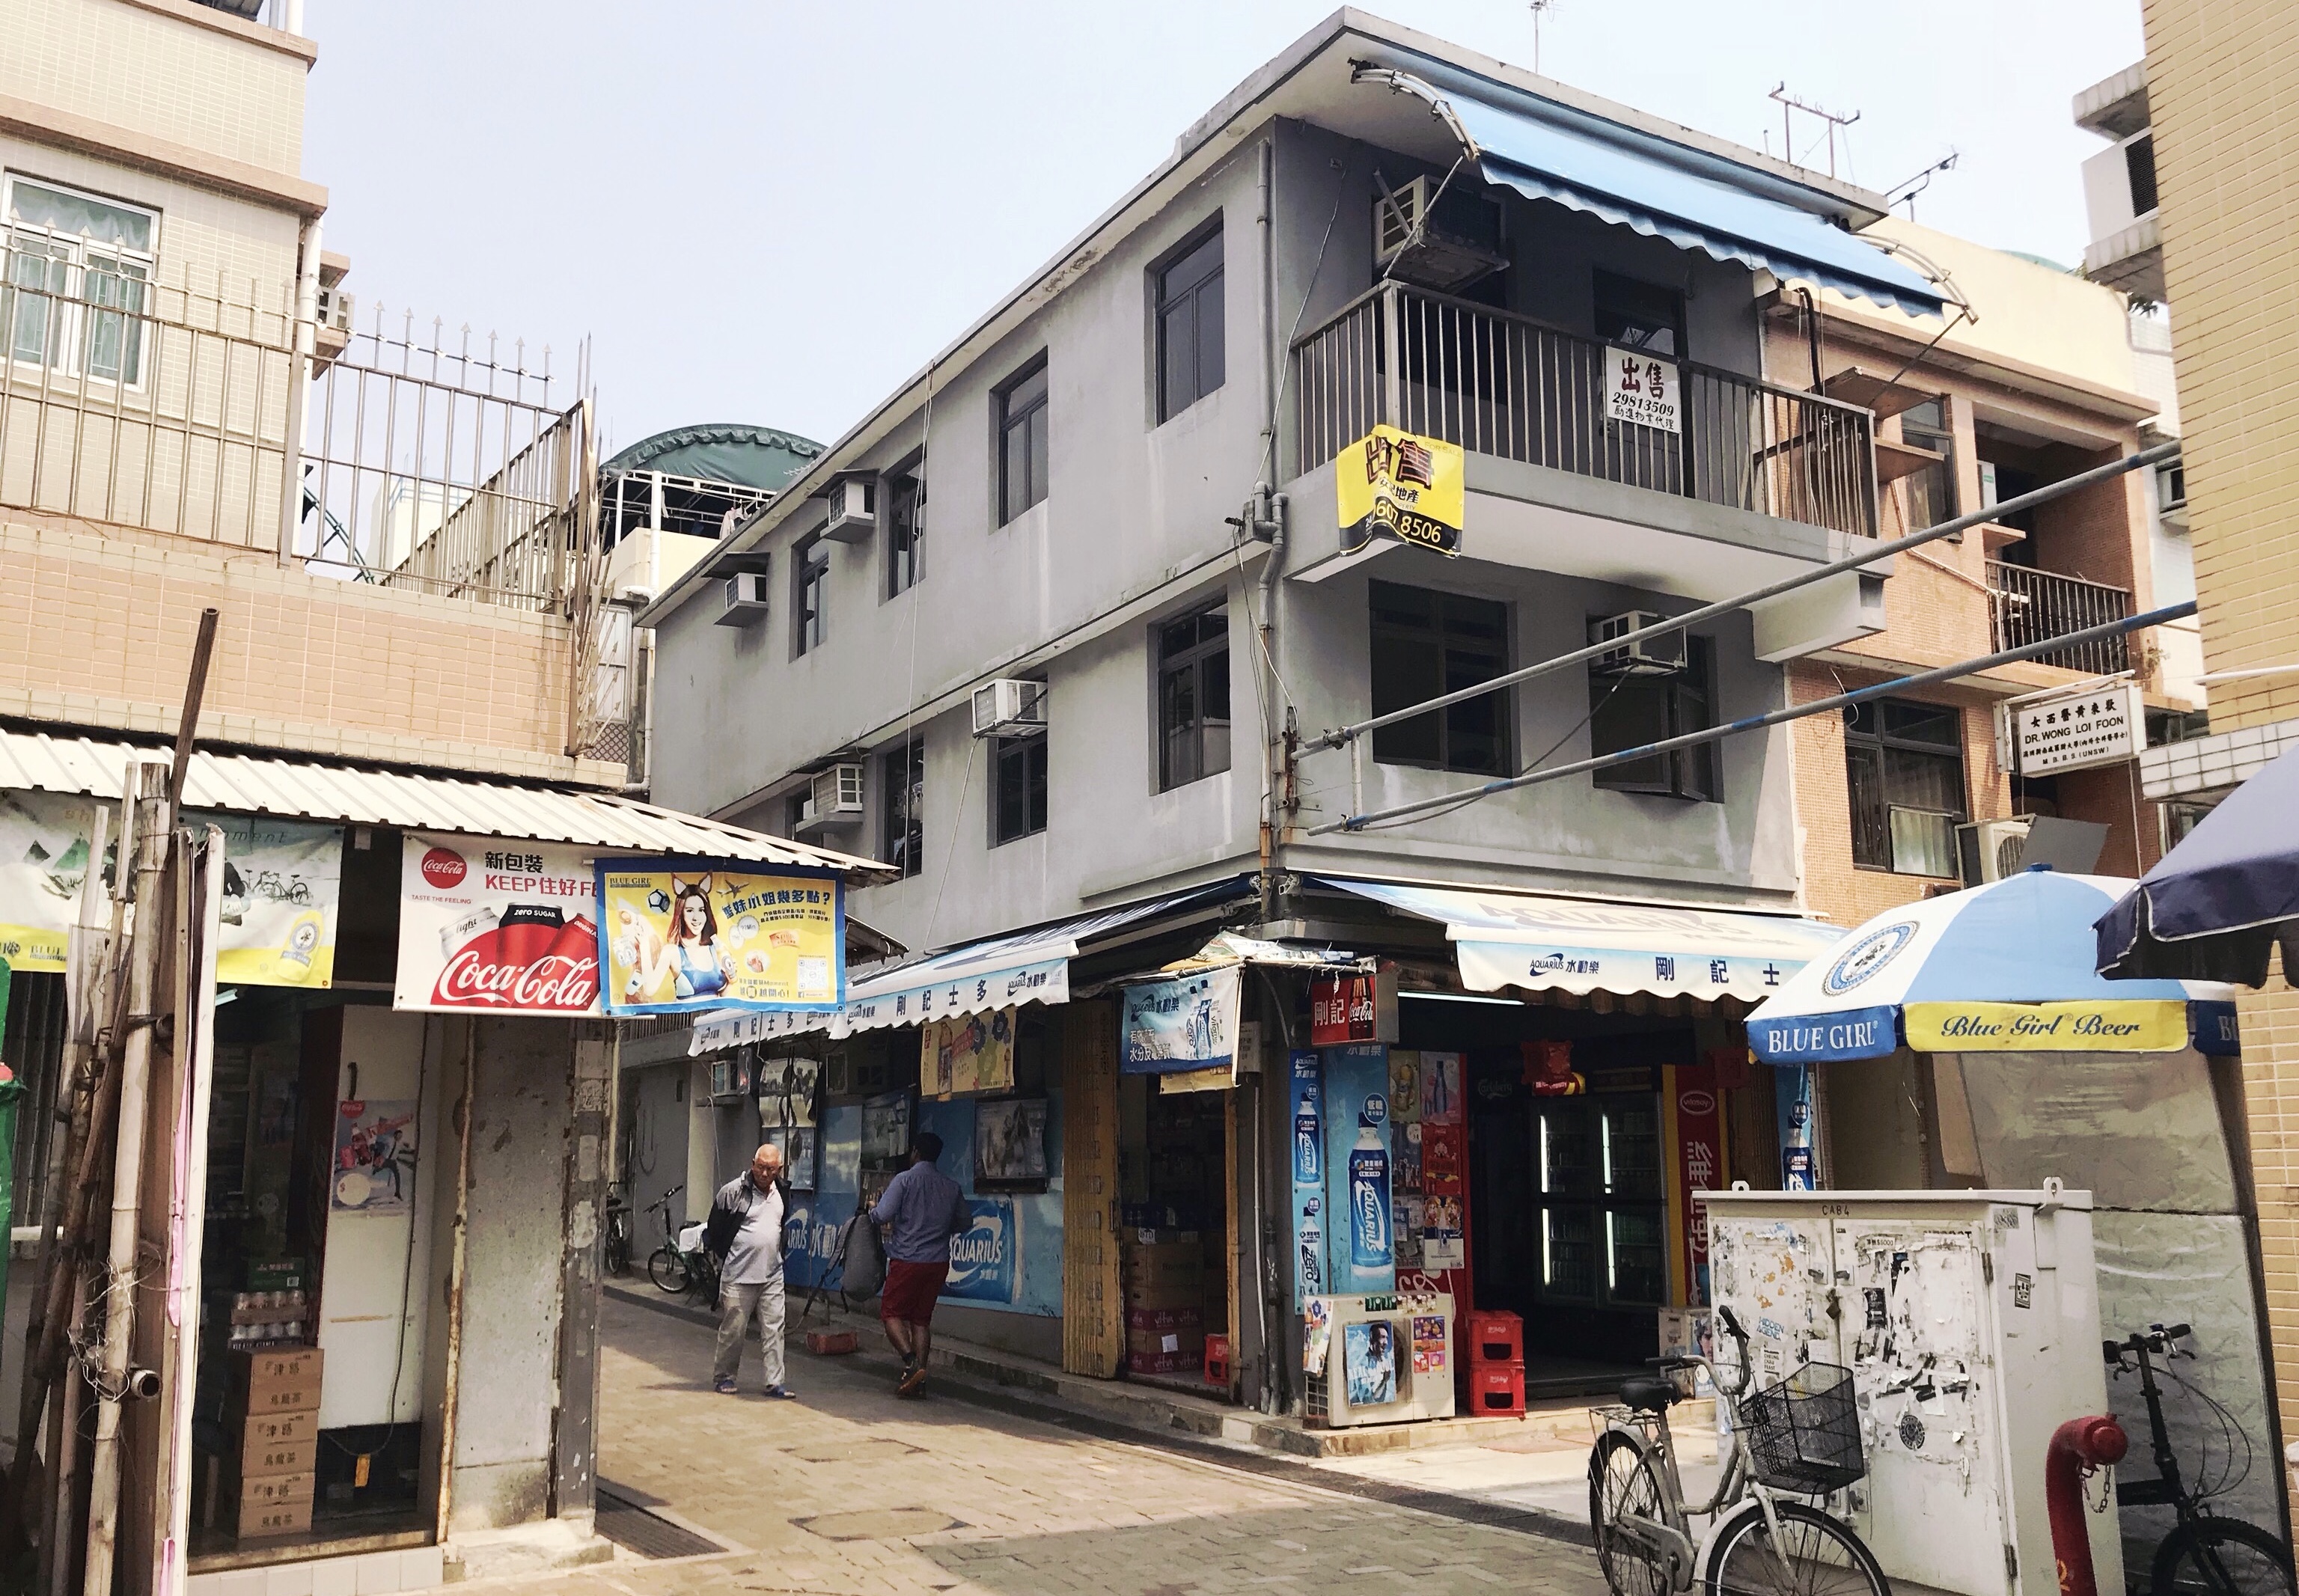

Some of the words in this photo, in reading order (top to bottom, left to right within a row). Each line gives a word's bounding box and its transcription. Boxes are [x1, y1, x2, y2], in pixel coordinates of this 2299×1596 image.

[1622, 357, 1665, 400] 出售
[1613, 392, 1674, 416] 29813509
[1425, 441, 1441, 452] FOR
[1365, 435, 1435, 490] 出售
[1400, 515, 1441, 542] 8506
[2024, 733, 2041, 745] DR.
[2042, 727, 2071, 741] WONG
[2076, 722, 2092, 735] LOI
[2096, 715, 2124, 730] FOON
[2079, 745, 2110, 759] (UNSW)
[424, 858, 464, 875] Coca-Cola
[485, 851, 543, 874] 新包裝
[486, 874, 537, 893] KEEP
[445, 896, 471, 905] FEELING
[513, 908, 533, 917] zero
[534, 910, 556, 919] SUGAR
[456, 917, 477, 935] light
[439, 950, 599, 1007] Coca-Cola
[1530, 958, 1564, 972] AQUARIUS
[1566, 960, 1600, 975] 水動樂
[1314, 999, 1346, 1027] 剛記
[1941, 1015, 2003, 1037] Blue
[2009, 1013, 2066, 1036] Girl
[2072, 1014, 2140, 1036] Beer
[1768, 1027, 1825, 1054] BLUE
[1829, 1021, 1875, 1049] GIRL
[1363, 1179, 1378, 1253] AQUARIUS
